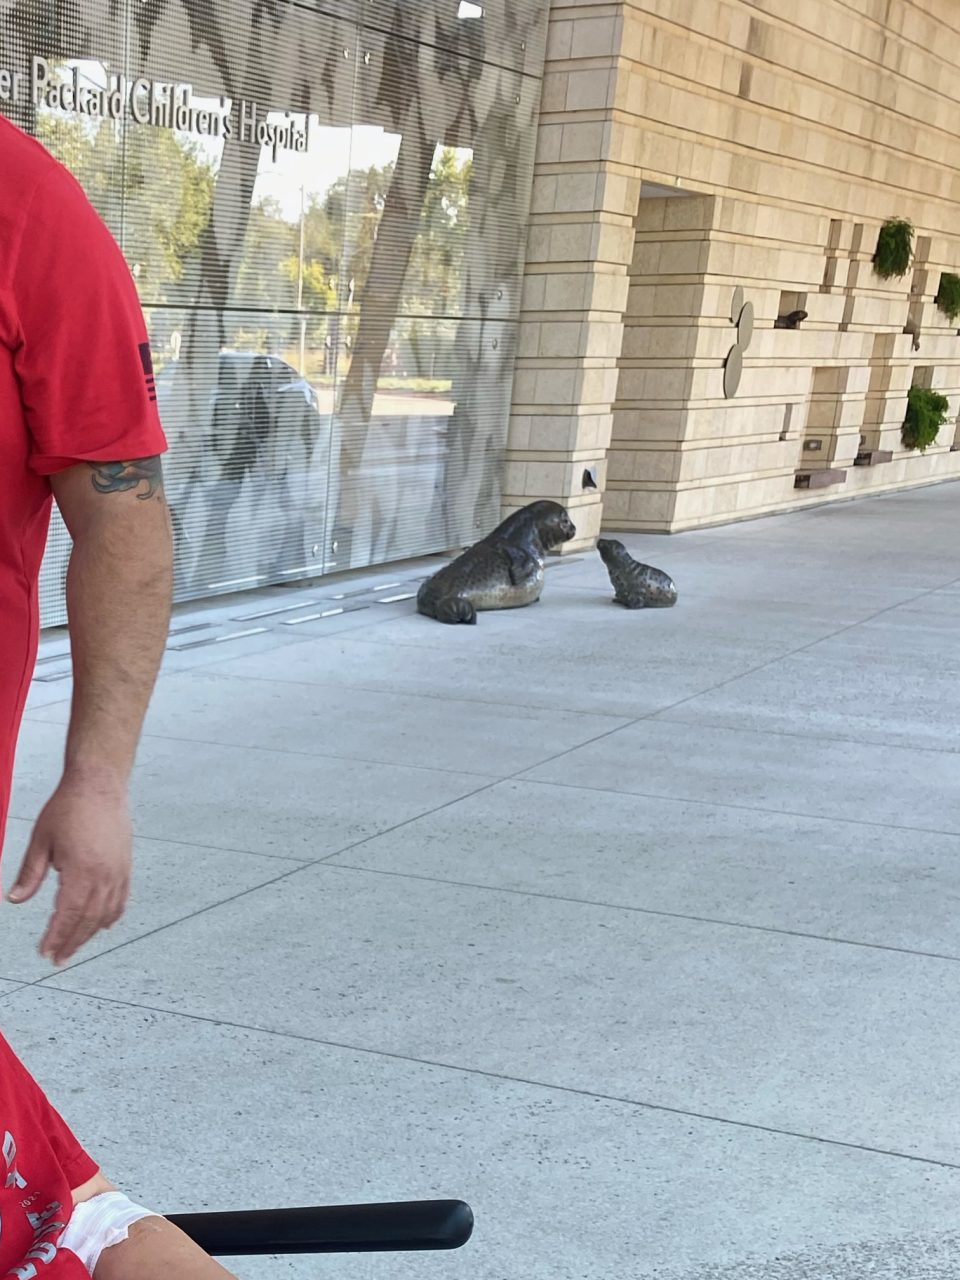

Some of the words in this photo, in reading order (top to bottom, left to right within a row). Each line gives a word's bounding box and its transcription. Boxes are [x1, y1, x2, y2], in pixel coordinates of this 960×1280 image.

[31, 55, 125, 119] Packard
[131, 78, 233, 140] Children's
[240, 100, 310, 163] Hospital
